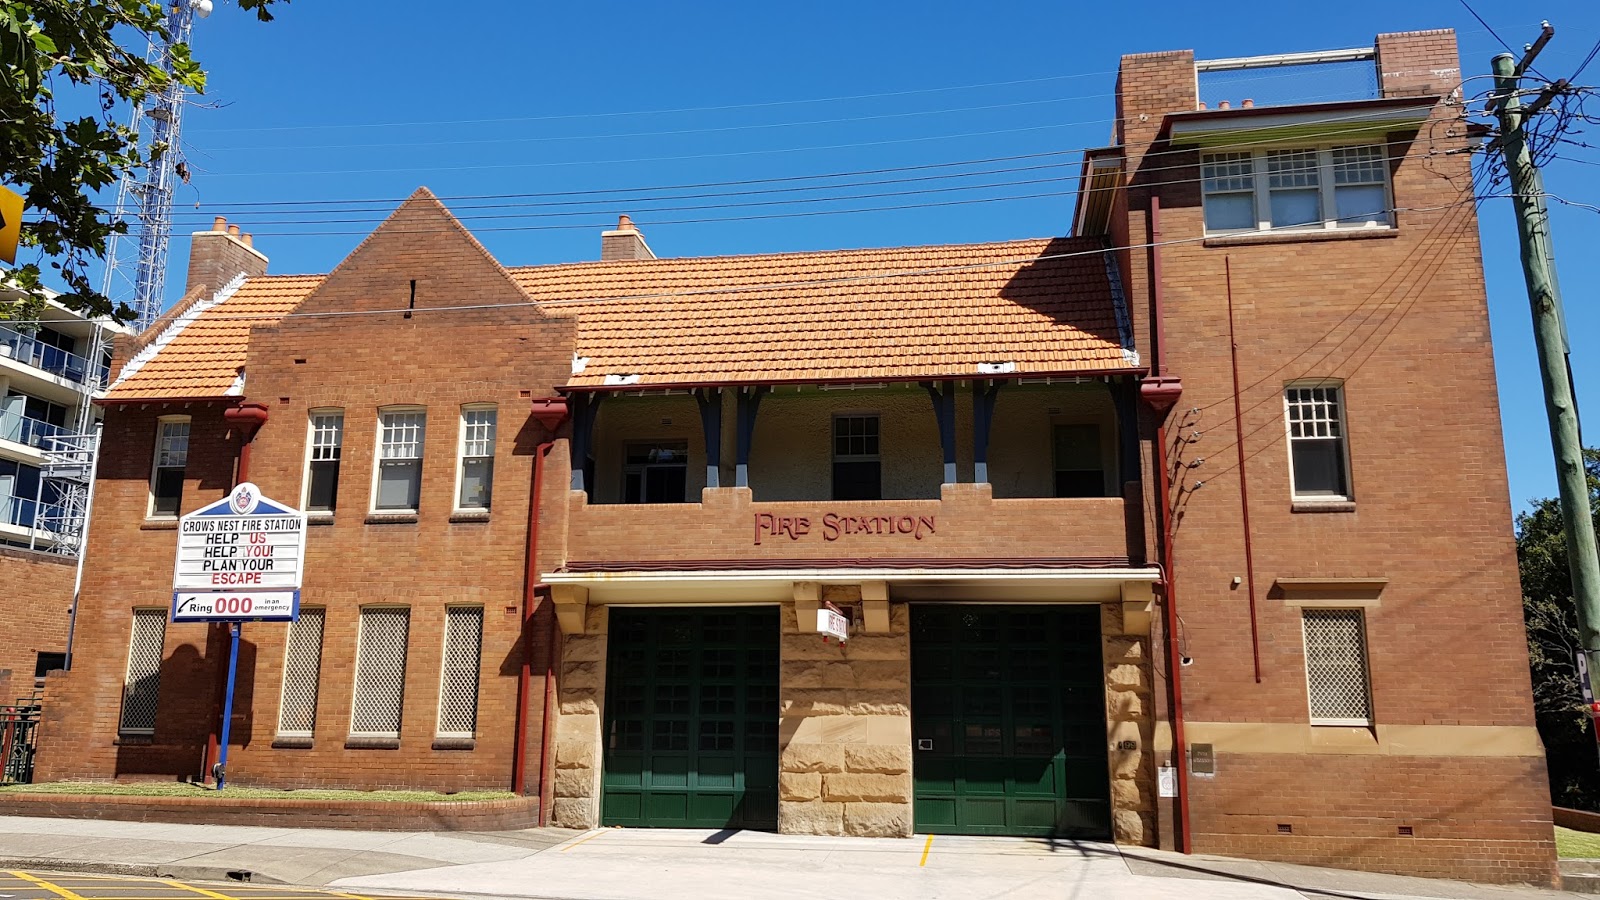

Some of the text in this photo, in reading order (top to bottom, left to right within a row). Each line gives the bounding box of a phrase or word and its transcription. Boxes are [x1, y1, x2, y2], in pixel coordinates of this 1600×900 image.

[183, 519, 301, 532] CROWS NEST FIRE STATION
[754, 512, 936, 545] FIRE STATION
[206, 532, 267, 544] HELP US
[205, 545, 274, 558] HELP YOU!
[203, 559, 274, 571] PLAN YOUR
[212, 573, 261, 584] ESCAPE
[189, 597, 253, 614] Ring 000
[1577, 653, 1588, 684] P
